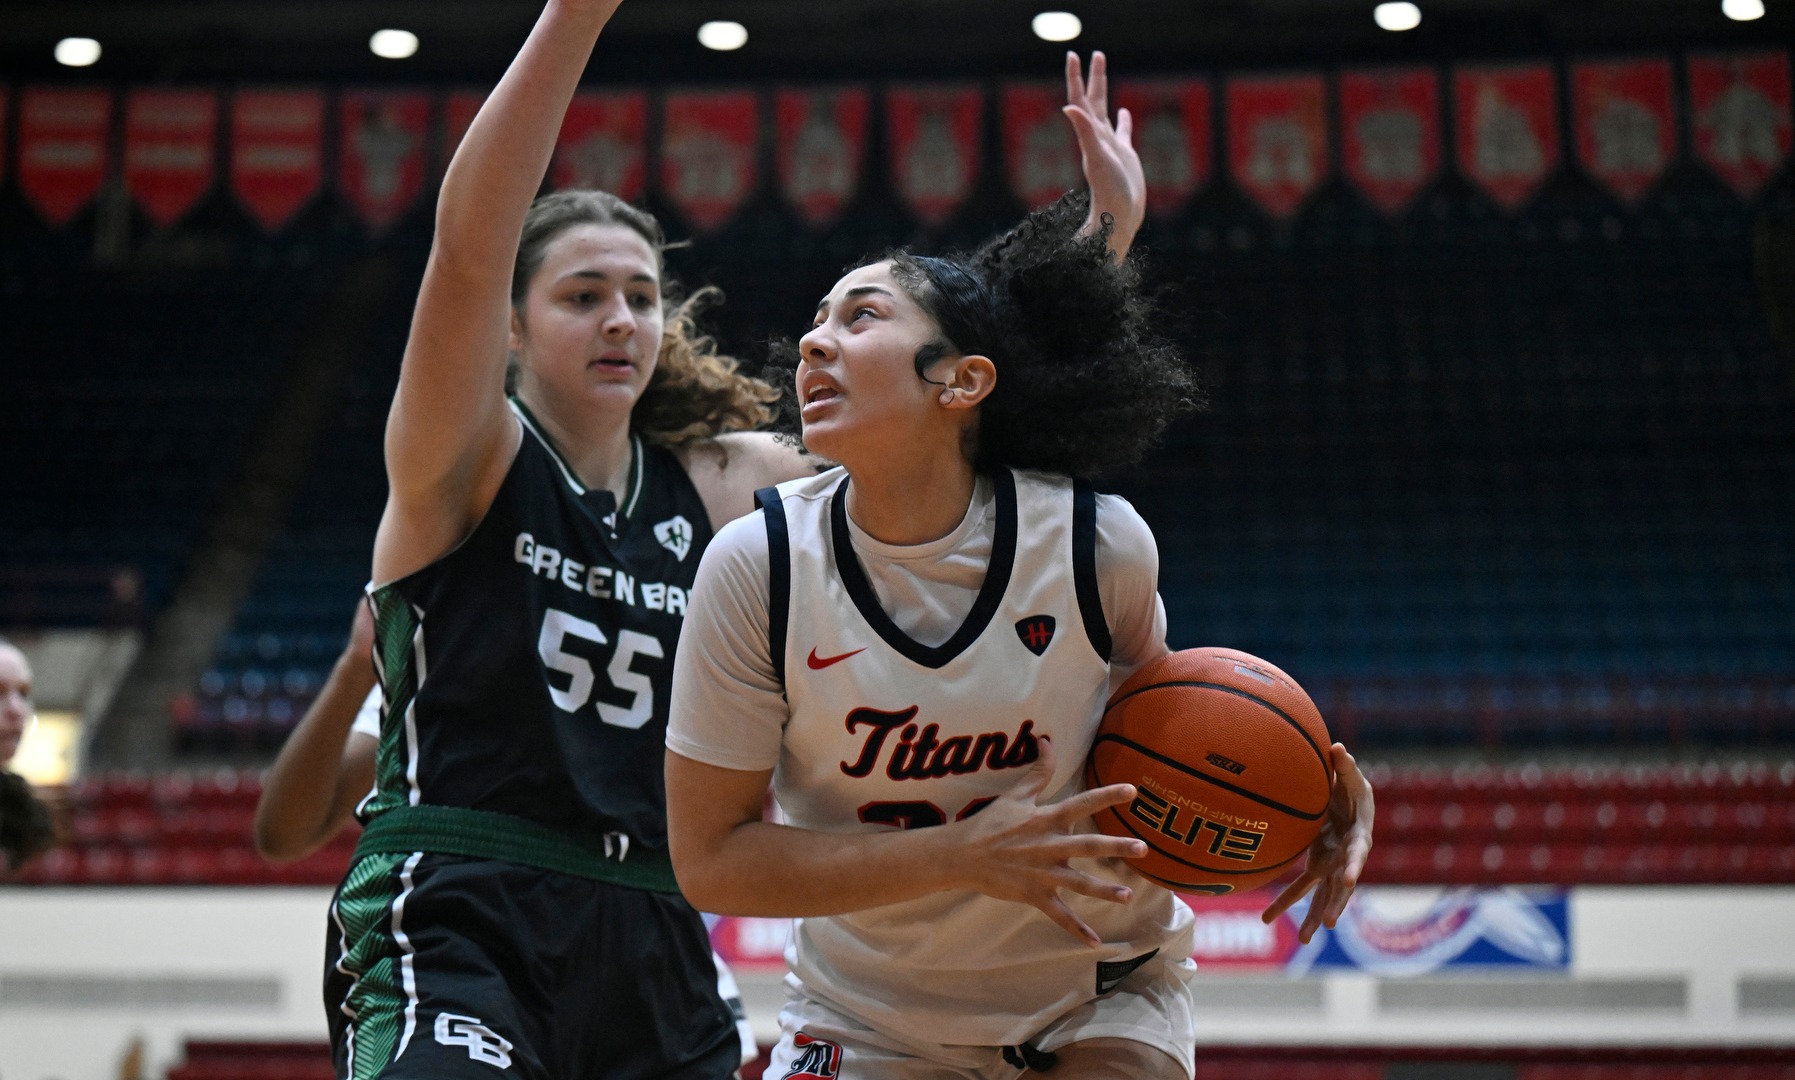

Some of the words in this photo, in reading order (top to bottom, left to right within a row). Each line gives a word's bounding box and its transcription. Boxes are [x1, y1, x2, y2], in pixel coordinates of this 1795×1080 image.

[513, 531, 636, 607] GREEN
[640, 581, 692, 617] BA
[538, 607, 665, 730] 55
[840, 704, 1050, 782] Titans
[1128, 784, 1265, 862] ELITE
[1142, 775, 1269, 830] CHAMPIONSHIP
[434, 1011, 513, 1070] GB
